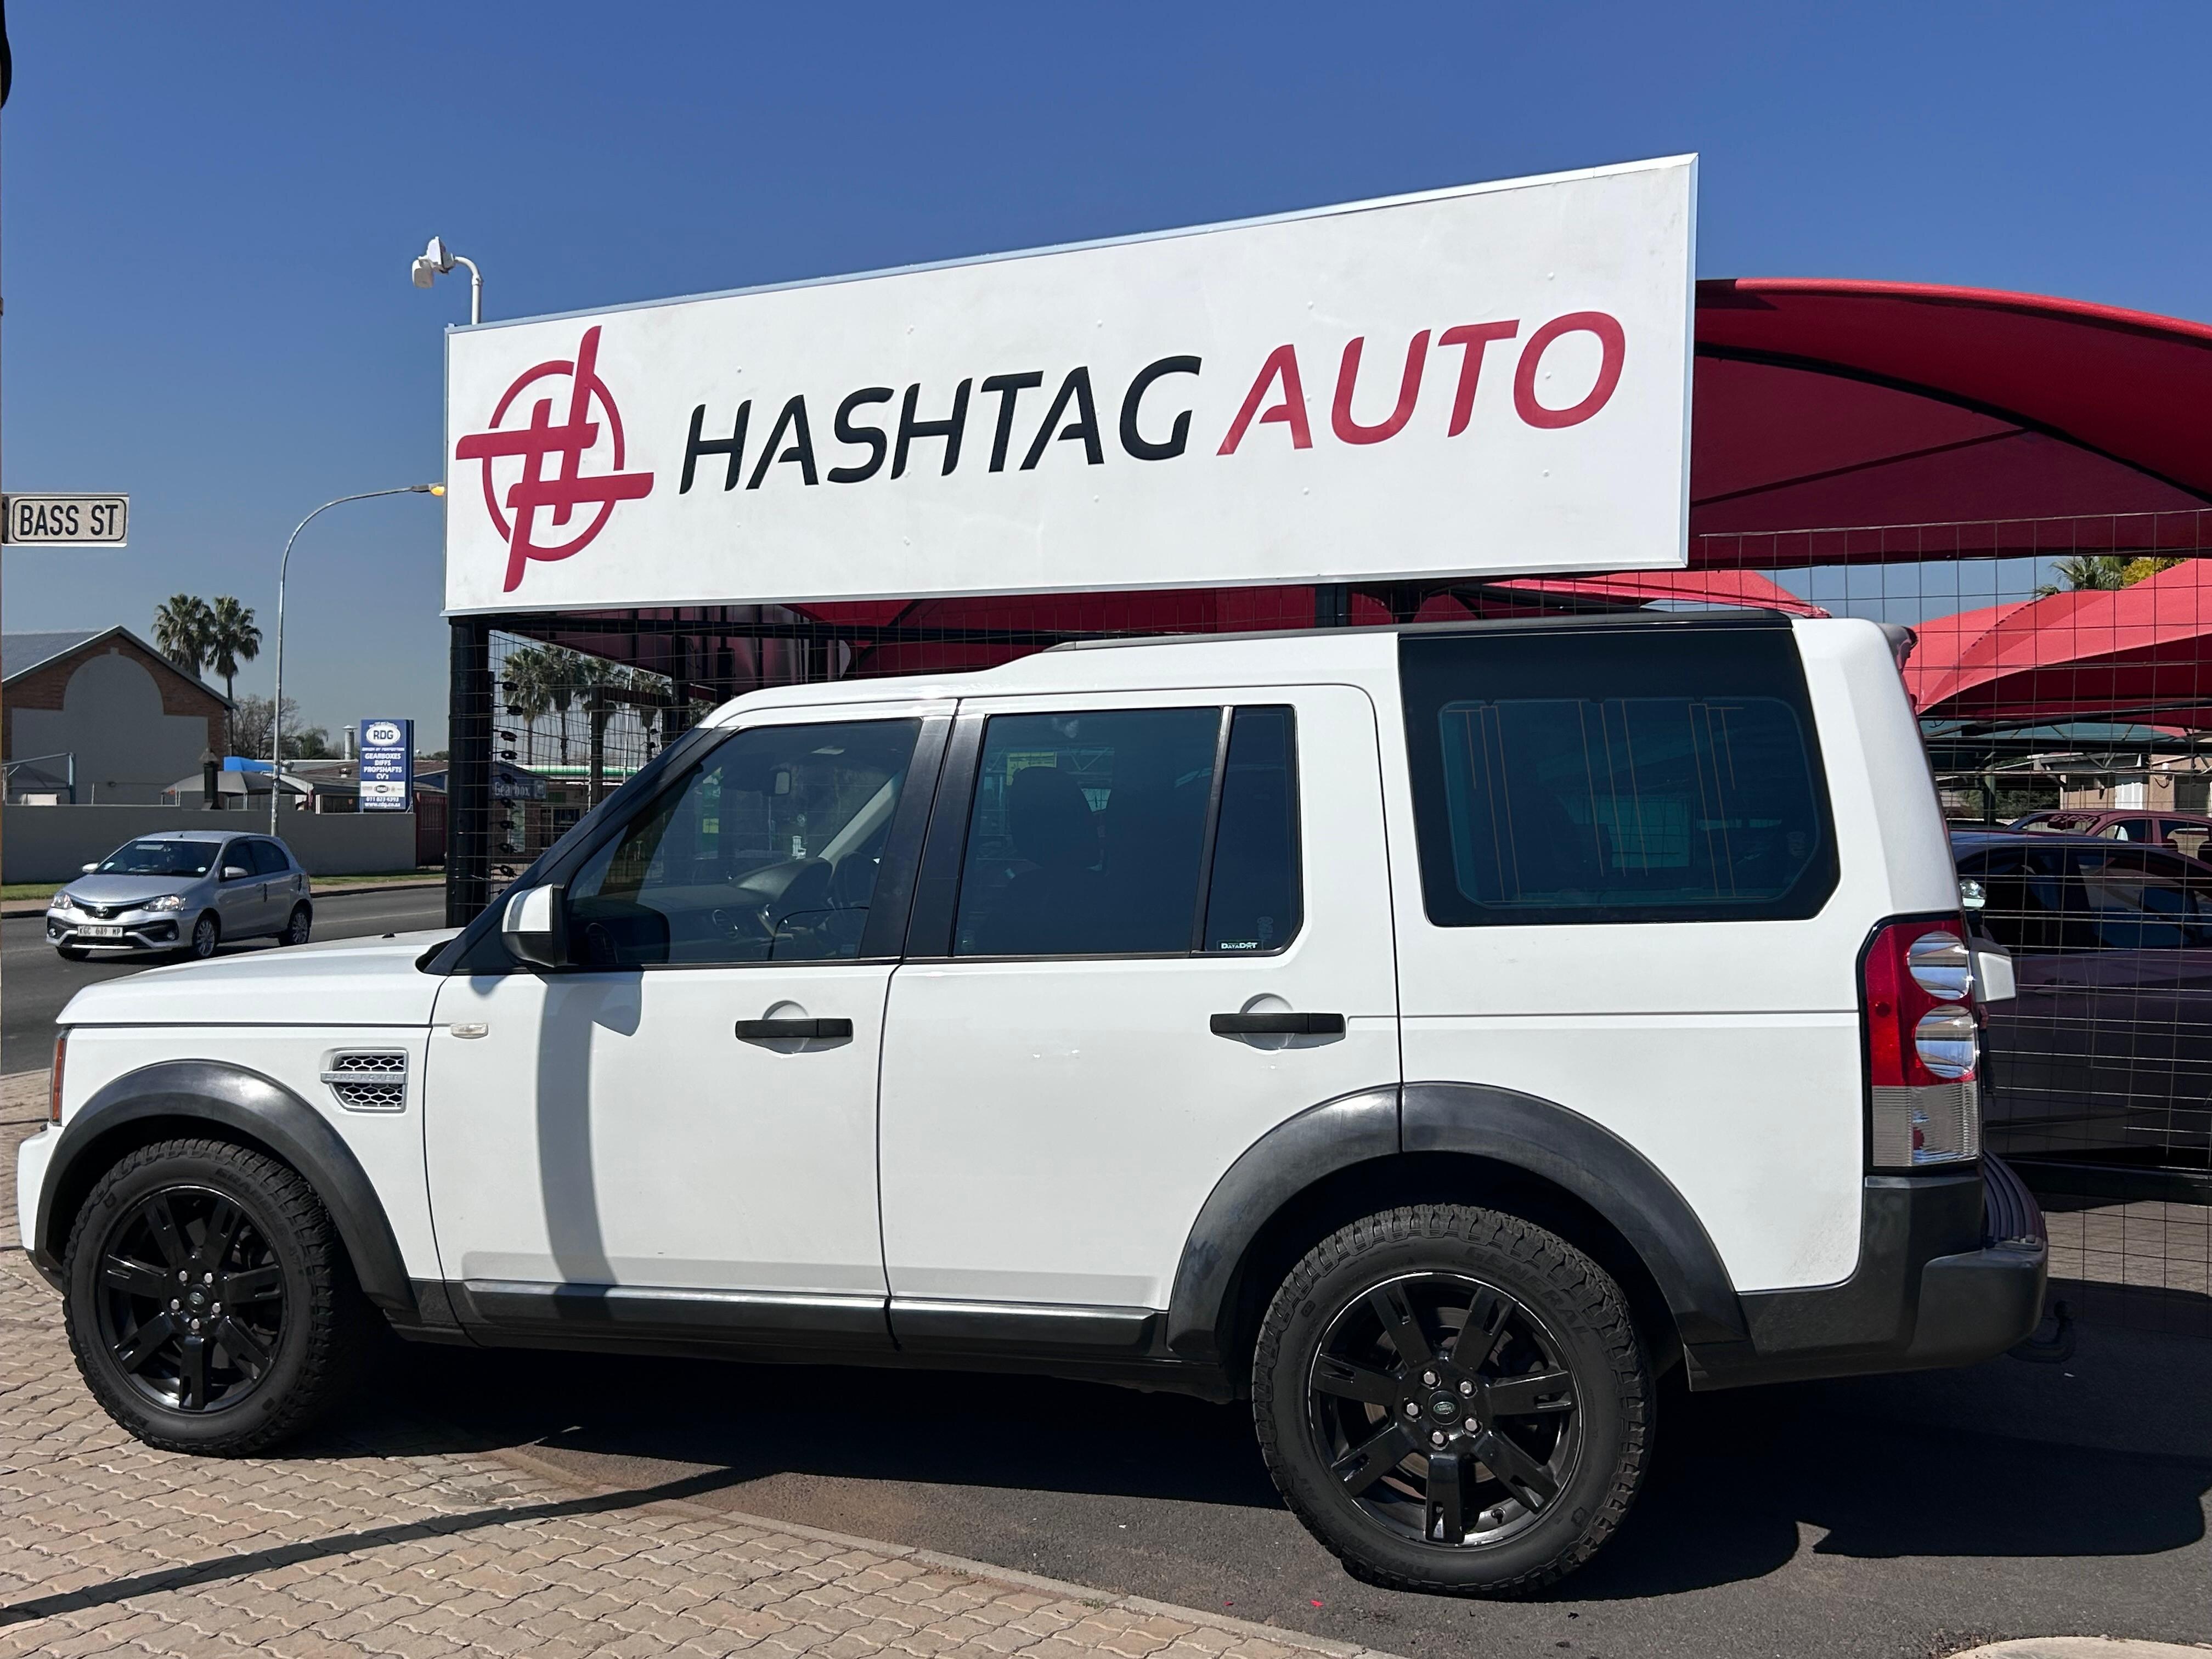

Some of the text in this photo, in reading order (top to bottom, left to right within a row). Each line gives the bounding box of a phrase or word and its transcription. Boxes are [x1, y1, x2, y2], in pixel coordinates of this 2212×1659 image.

[680, 312, 1625, 494] HASHTAG AUTO
[20, 504, 119, 535] BASS ST
[373, 730, 393, 740] RDG
[1465, 1246, 1590, 1344] GENERAL
